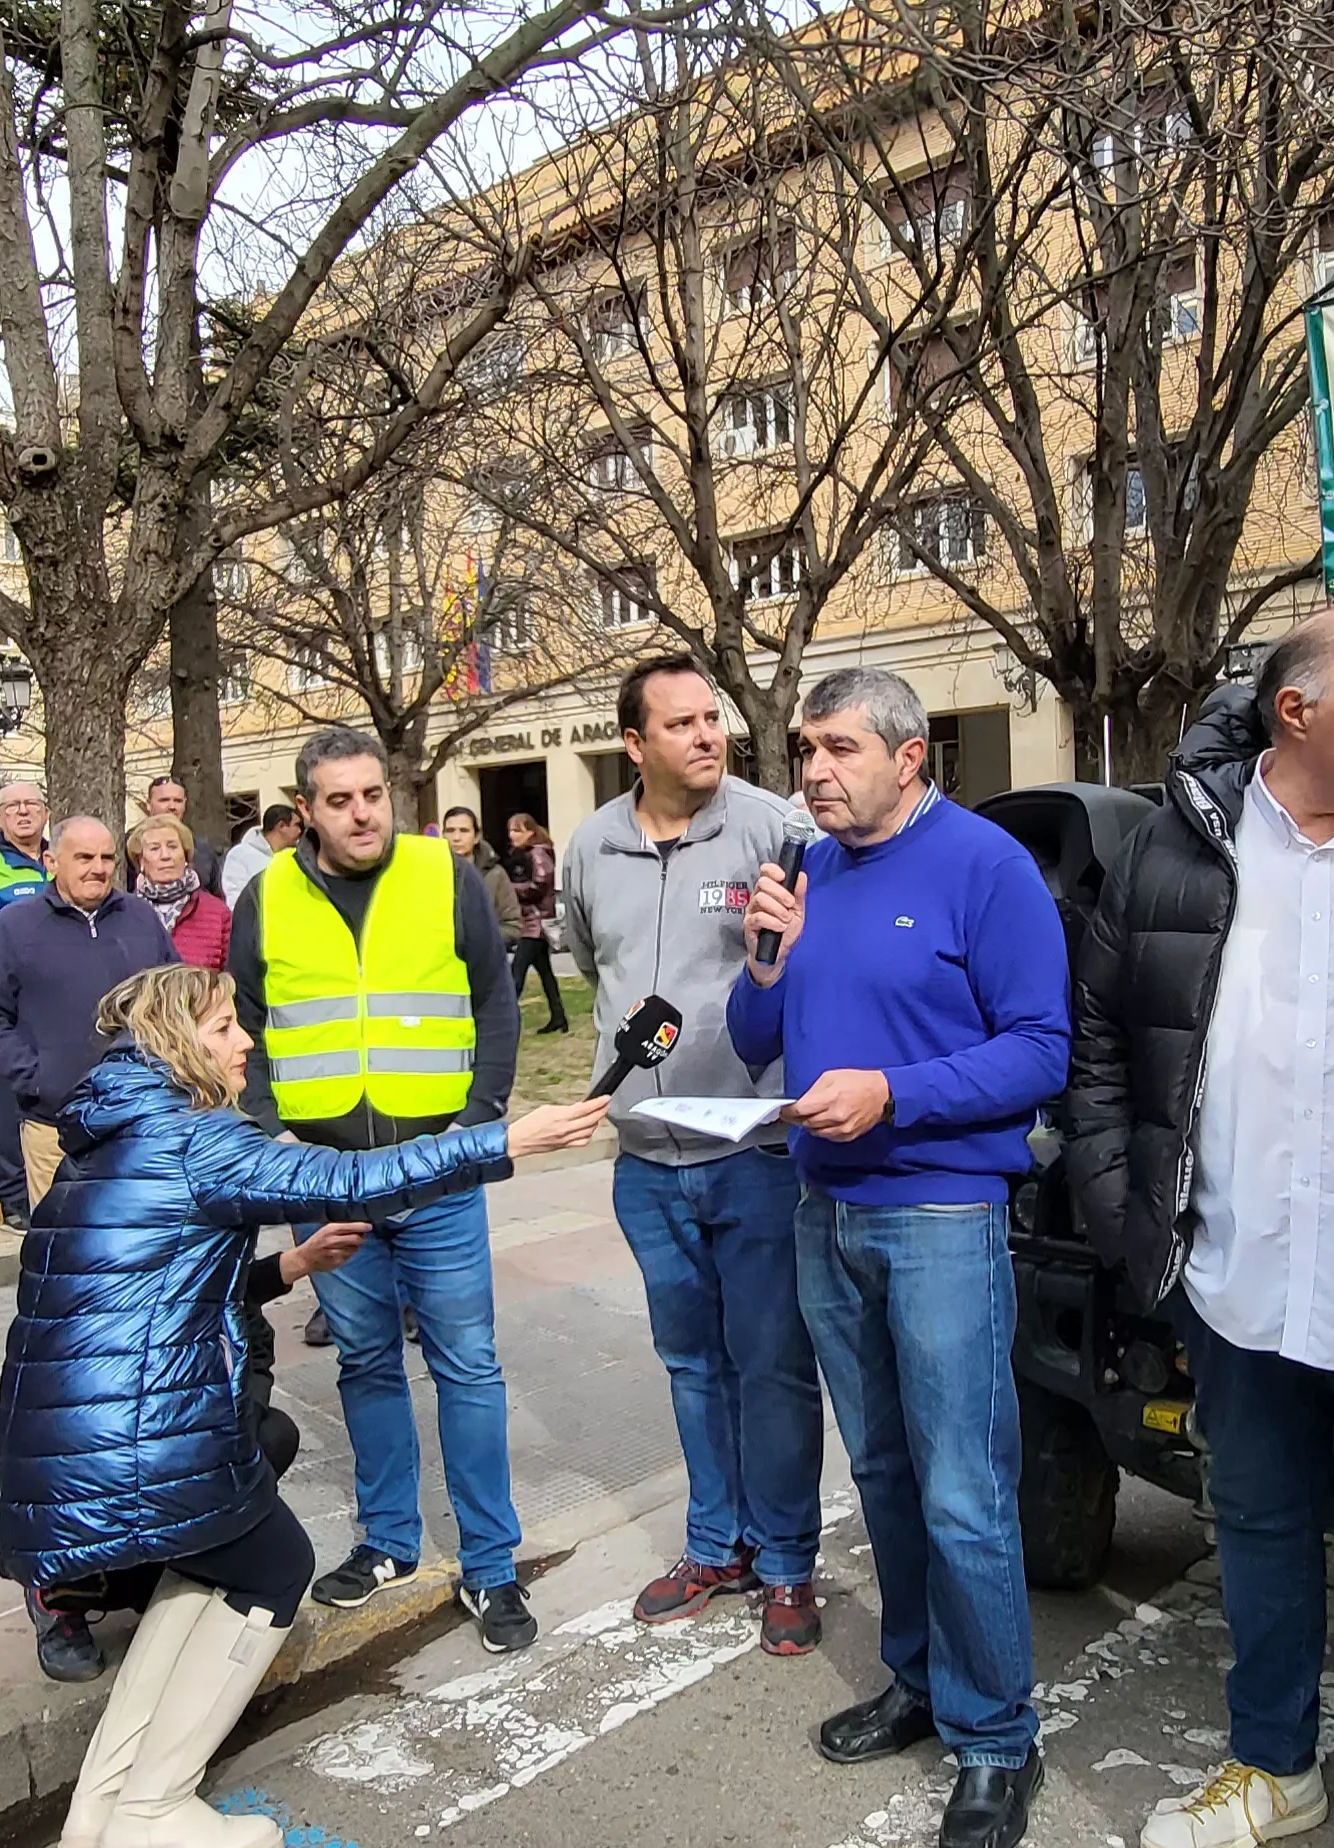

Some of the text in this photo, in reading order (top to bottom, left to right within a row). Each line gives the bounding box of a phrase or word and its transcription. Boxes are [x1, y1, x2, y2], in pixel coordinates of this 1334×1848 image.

[541, 728, 562, 748] DE
[570, 721, 616, 744] ARAG
[703, 889, 748, 907] 1985
[700, 906, 723, 915] NEW
